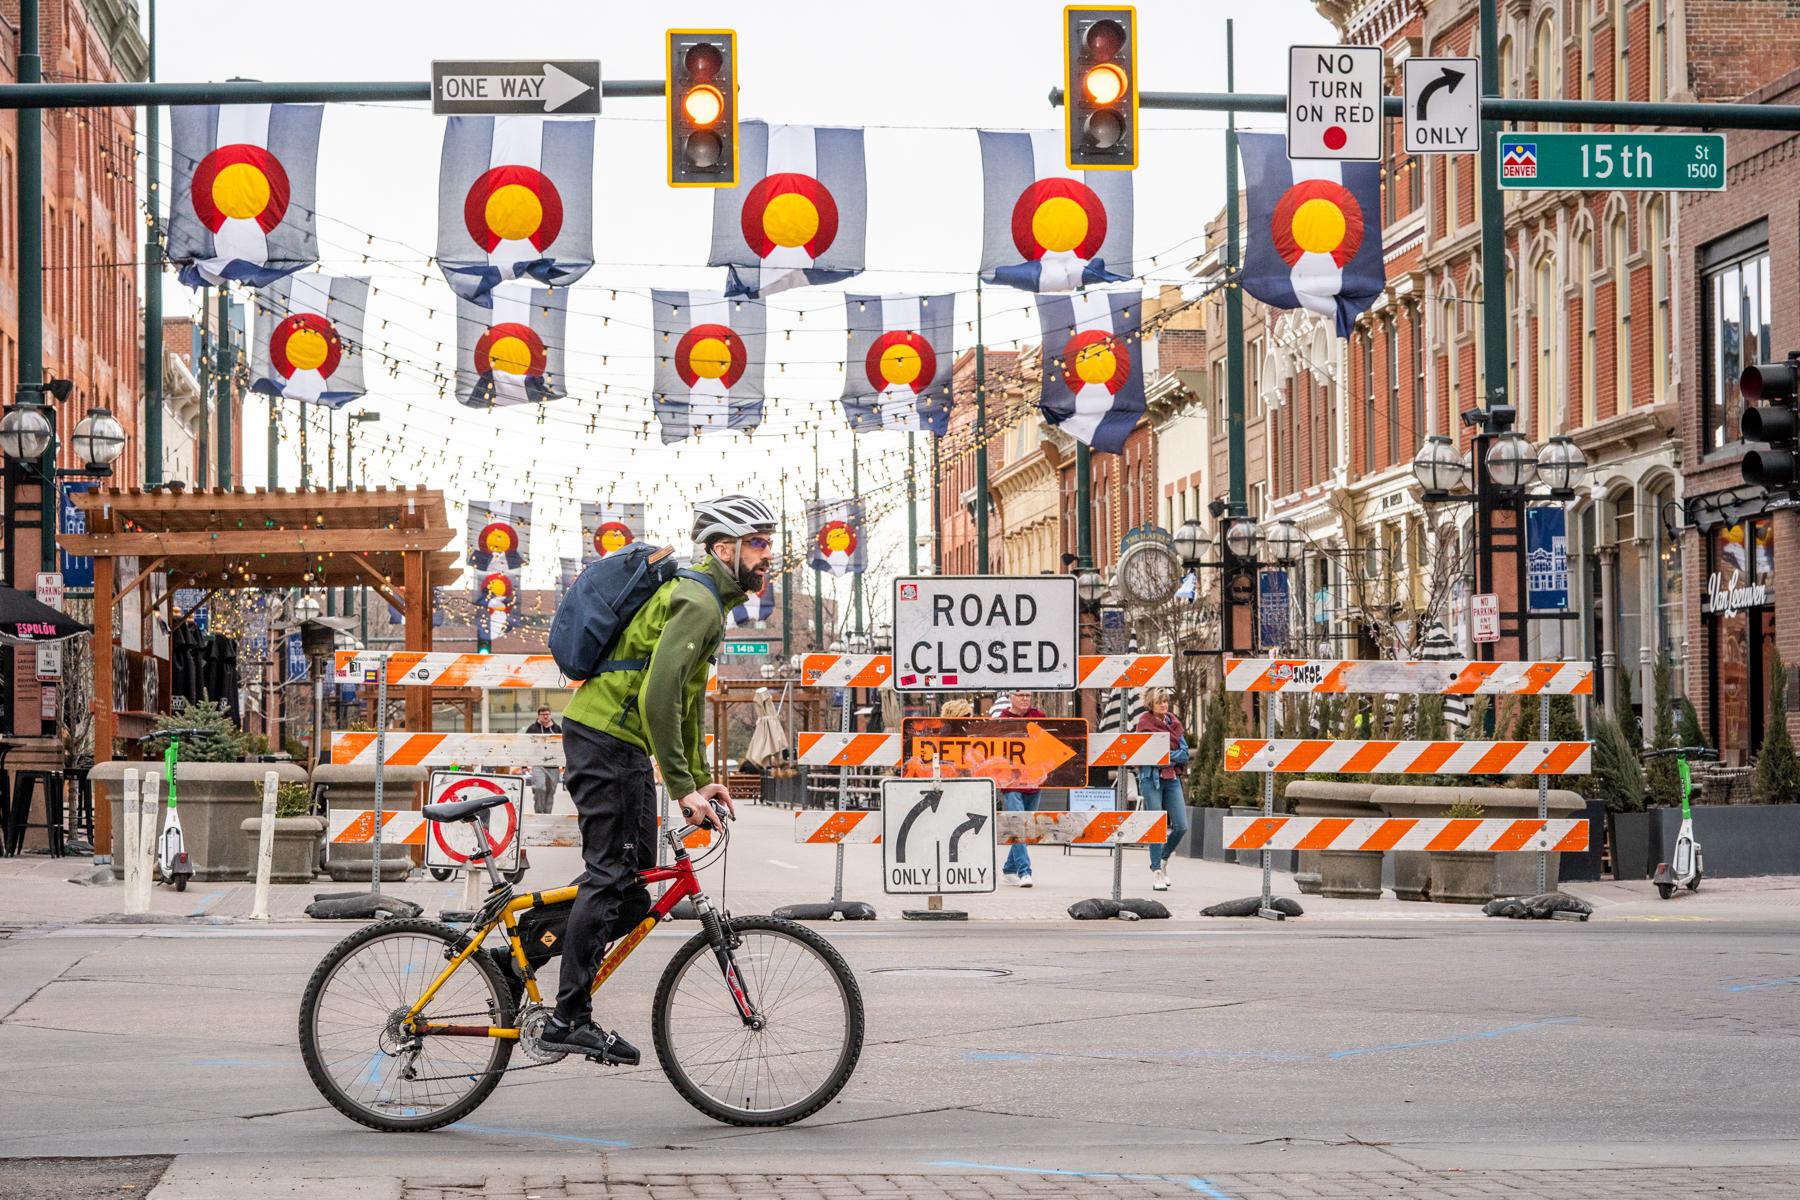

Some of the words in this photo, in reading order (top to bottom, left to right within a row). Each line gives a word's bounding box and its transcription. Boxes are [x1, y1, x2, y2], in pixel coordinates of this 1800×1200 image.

[1317, 54, 1354, 74] NO
[446, 78, 488, 98] ONE
[500, 78, 545, 98] WAY
[1309, 81, 1362, 98] TURN
[1296, 105, 1323, 122] ON
[1335, 106, 1374, 123] RED
[1416, 127, 1468, 145] ONLY
[1580, 144, 1653, 178] 15th
[1695, 145, 1710, 160] St
[1503, 166, 1537, 177] DENVER
[1687, 163, 1717, 178] 1500
[45, 576, 54, 585] NO
[39, 586, 61, 596] PARKING
[1708, 572, 1729, 613] Van
[933, 593, 1037, 627] ROAD
[1480, 597, 1489, 606] NO
[1472, 607, 1496, 616] PARKING
[911, 640, 1060, 675] CLOSED
[920, 740, 1026, 765] DETOUR
[892, 868, 931, 886] ONLY
[946, 867, 987, 885] ONLY
